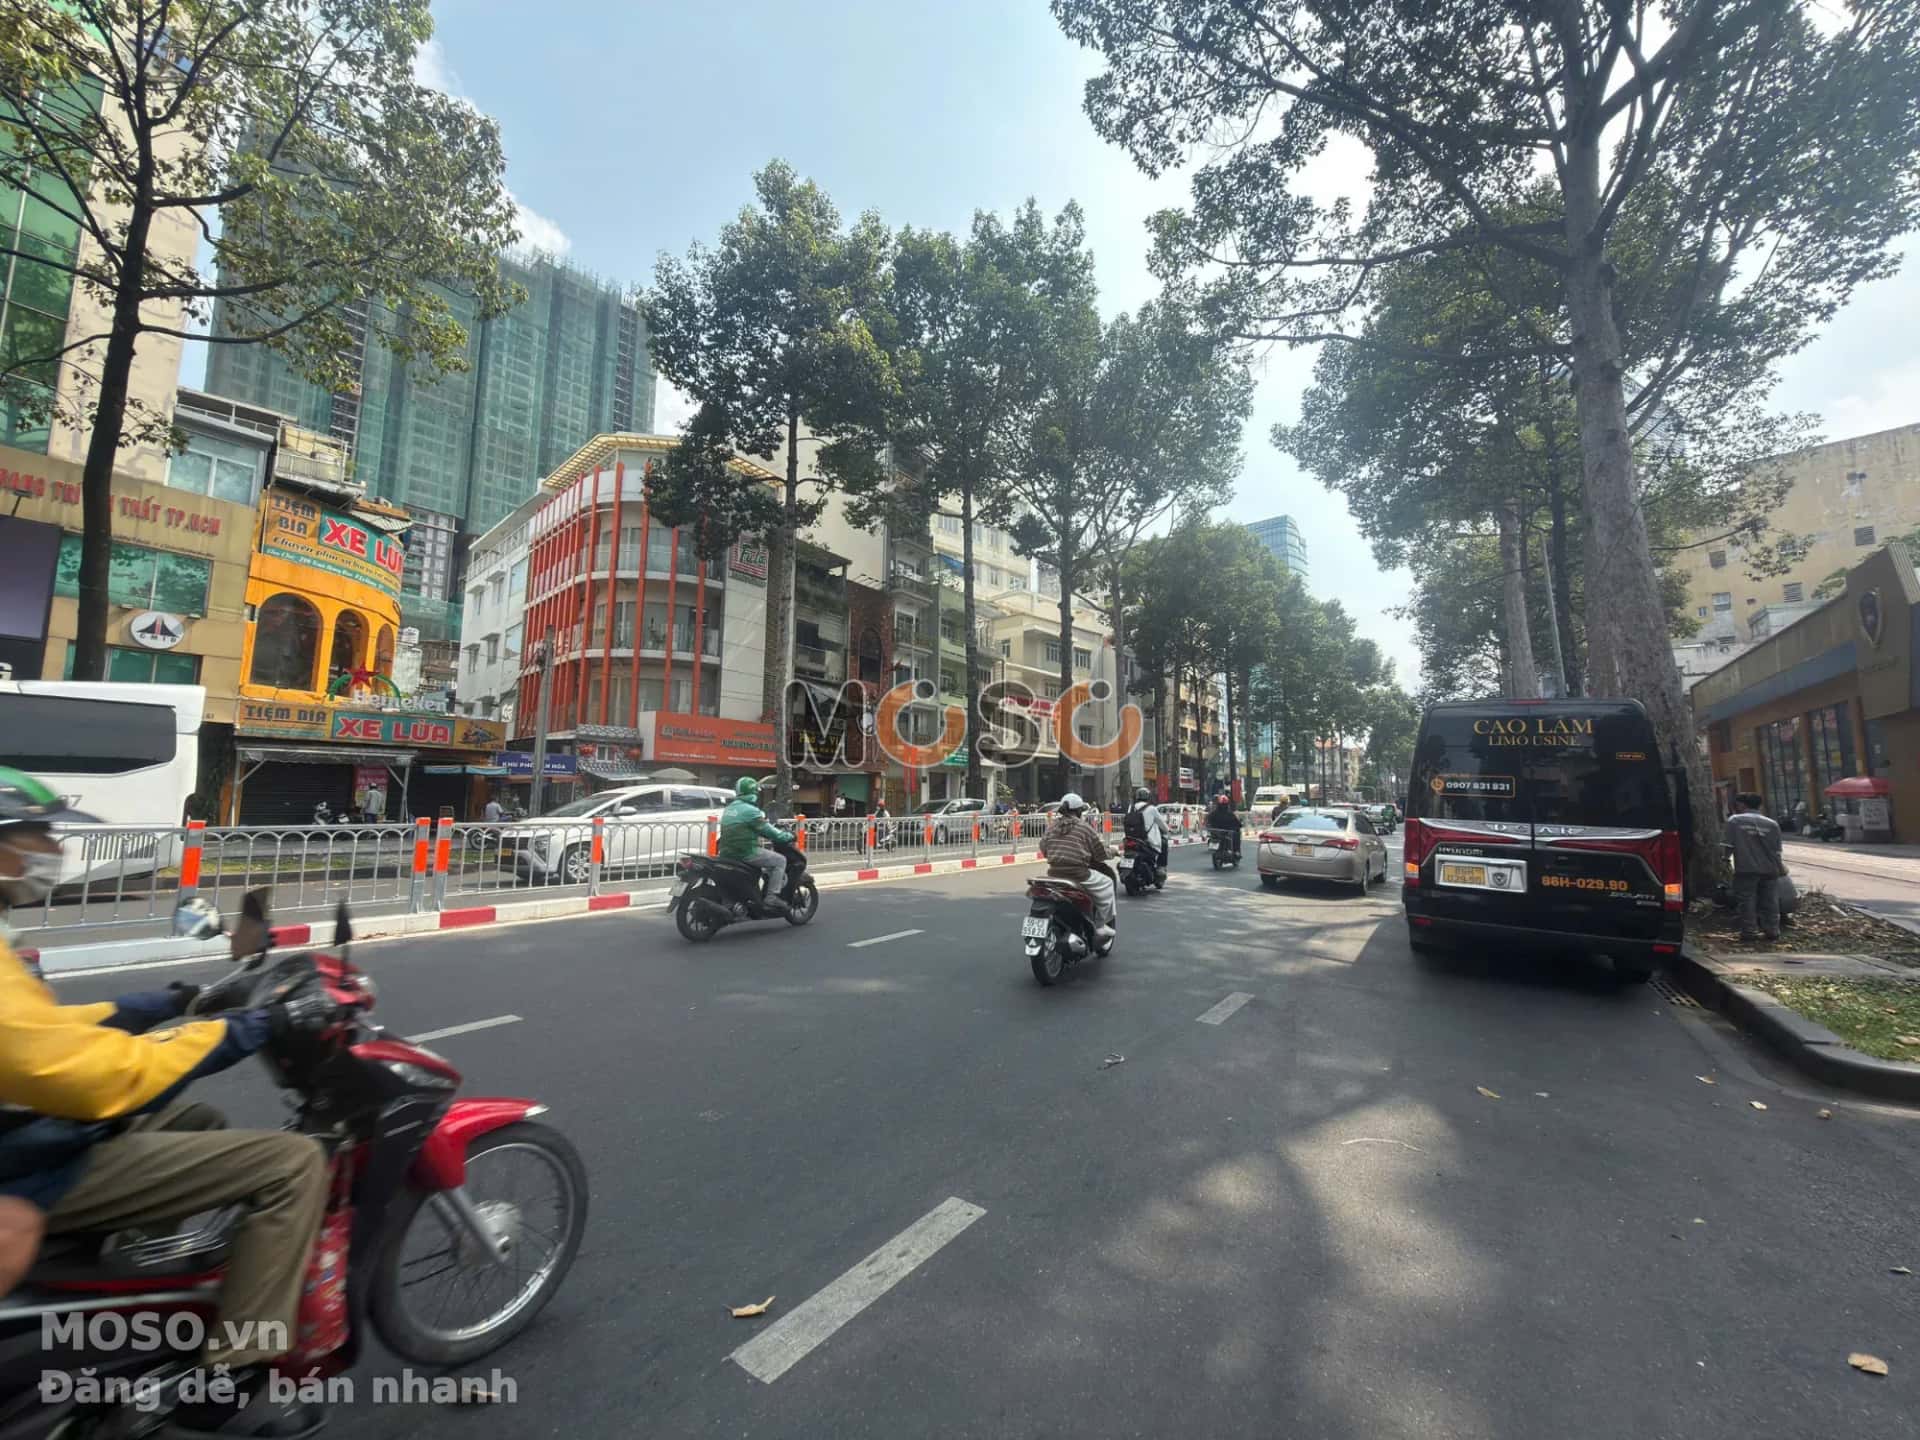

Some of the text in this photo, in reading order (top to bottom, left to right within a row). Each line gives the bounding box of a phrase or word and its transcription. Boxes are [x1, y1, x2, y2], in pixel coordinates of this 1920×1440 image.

[120, 496, 161, 523] THẤT
[167, 507, 221, 536] TP.HCM
[272, 495, 316, 519] TIỆM
[278, 516, 308, 535] BIA
[323, 517, 368, 557] XE
[352, 688, 449, 713] Heineken
[244, 704, 327, 723] TIỆM BIA
[337, 717, 383, 740] XE
[392, 717, 451, 744] LỬA
[1473, 718, 1593, 734] CAO LAM
[1488, 735, 1581, 746] LIMOUSINE
[1541, 876, 1629, 891] 86H-029.90
